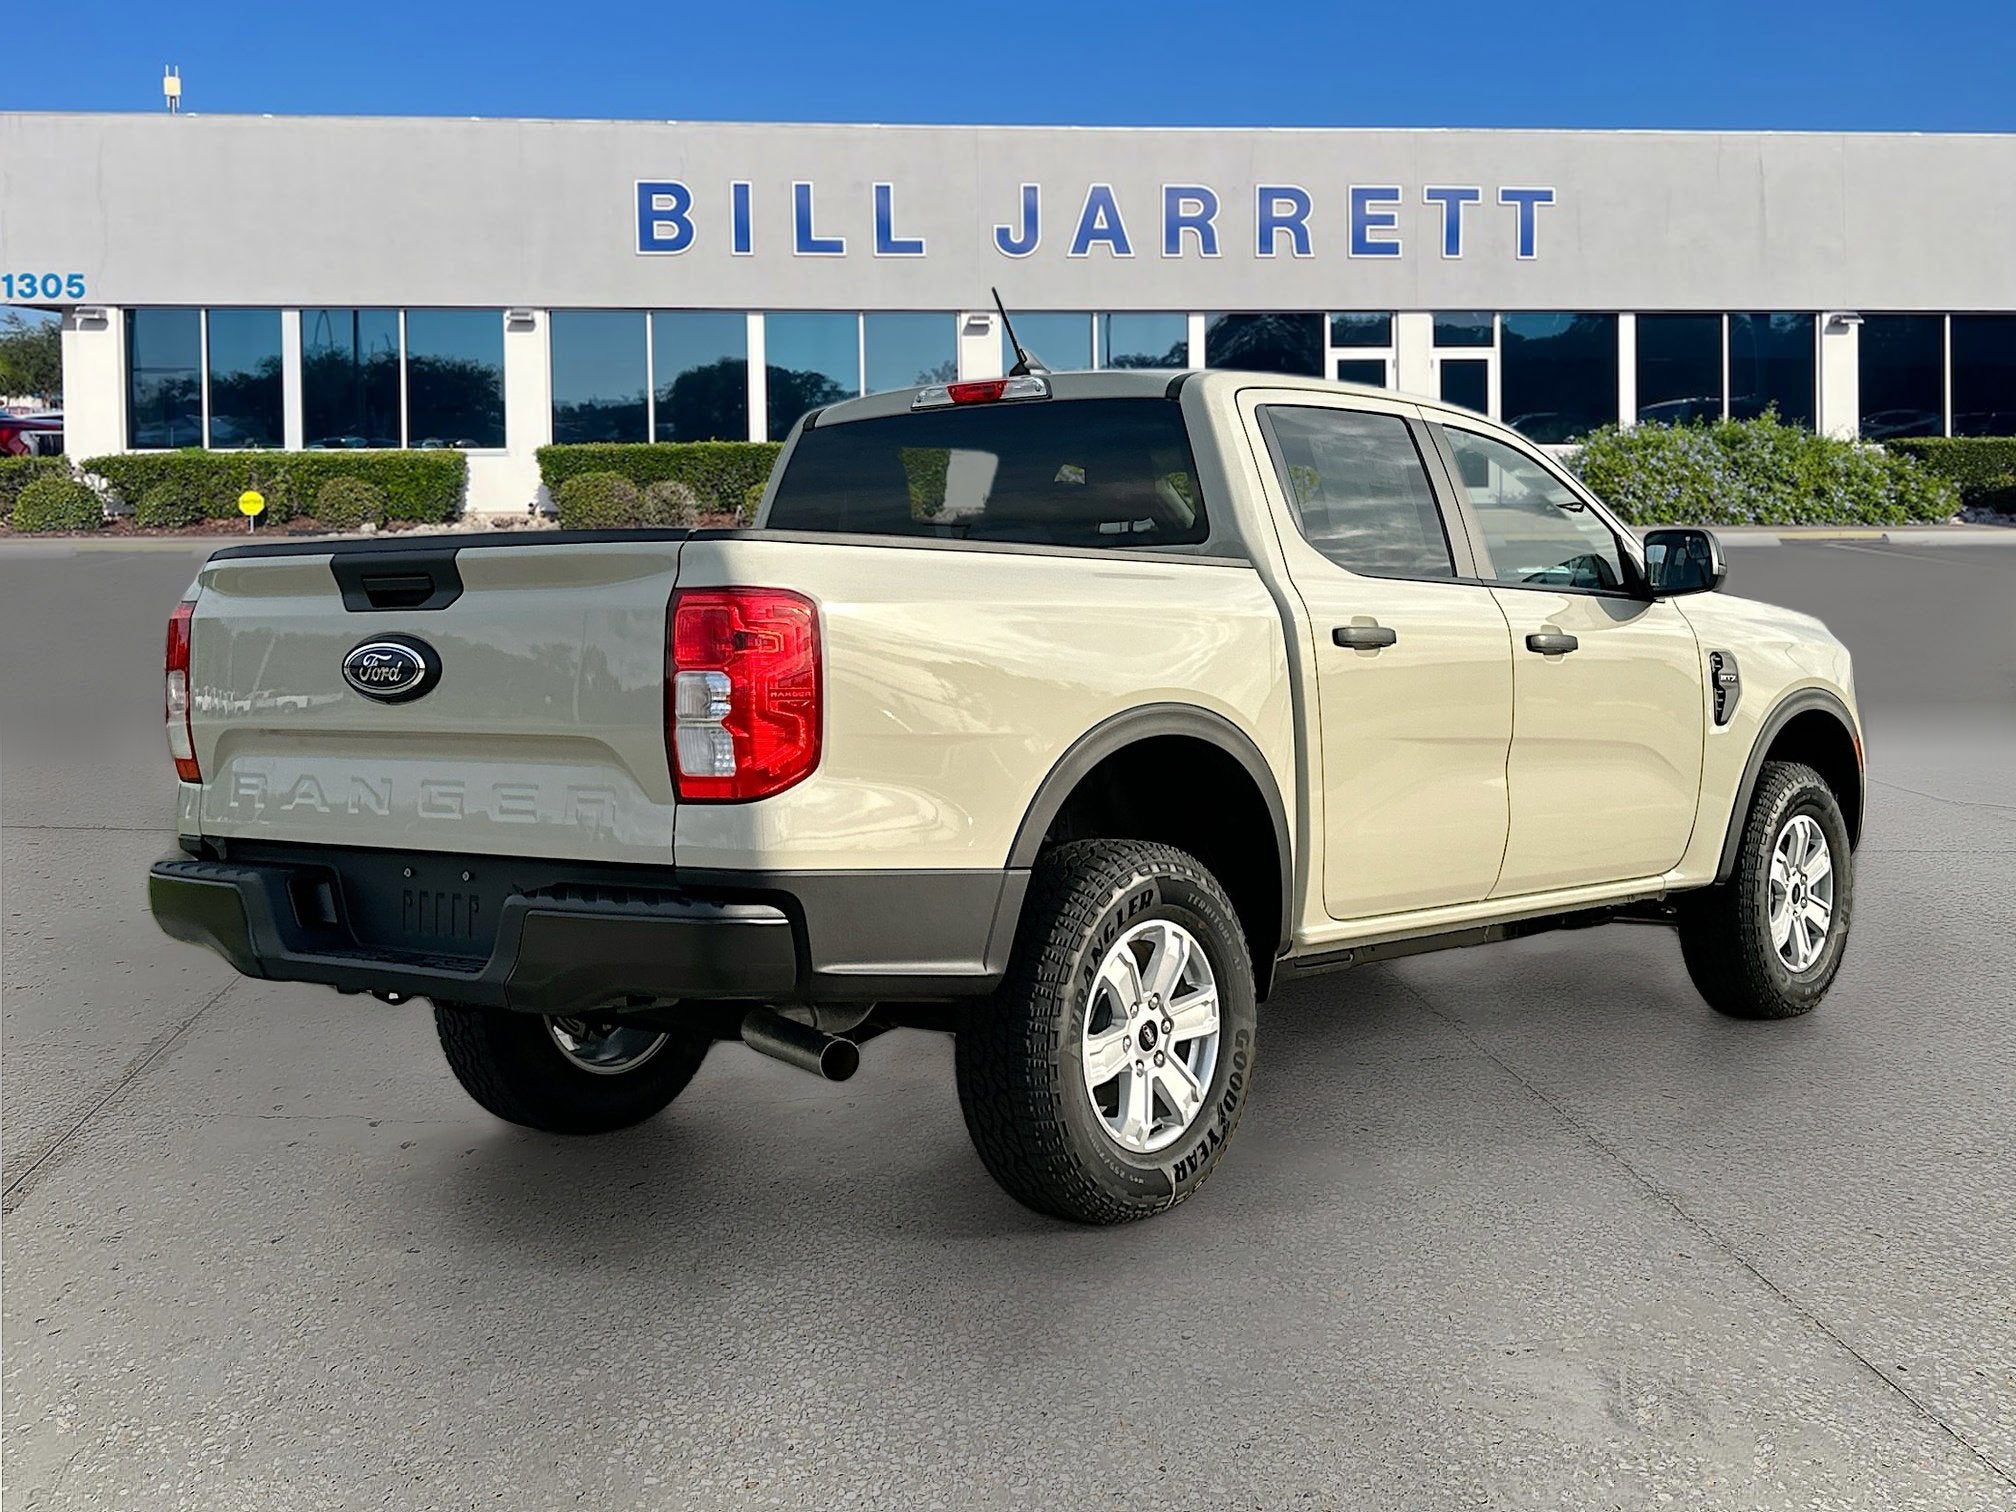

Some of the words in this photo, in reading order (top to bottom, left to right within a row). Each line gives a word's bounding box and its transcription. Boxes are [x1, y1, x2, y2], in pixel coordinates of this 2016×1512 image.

[635, 180, 926, 258] BILL
[993, 182, 1556, 261] JARRETT
[1, 273, 86, 299] 1305
[359, 653, 403, 682] Ford
[229, 772, 618, 826] RANGER
[1069, 888, 1154, 1044] WRANGLER
[1172, 1028, 1250, 1183] GOODYEAR
